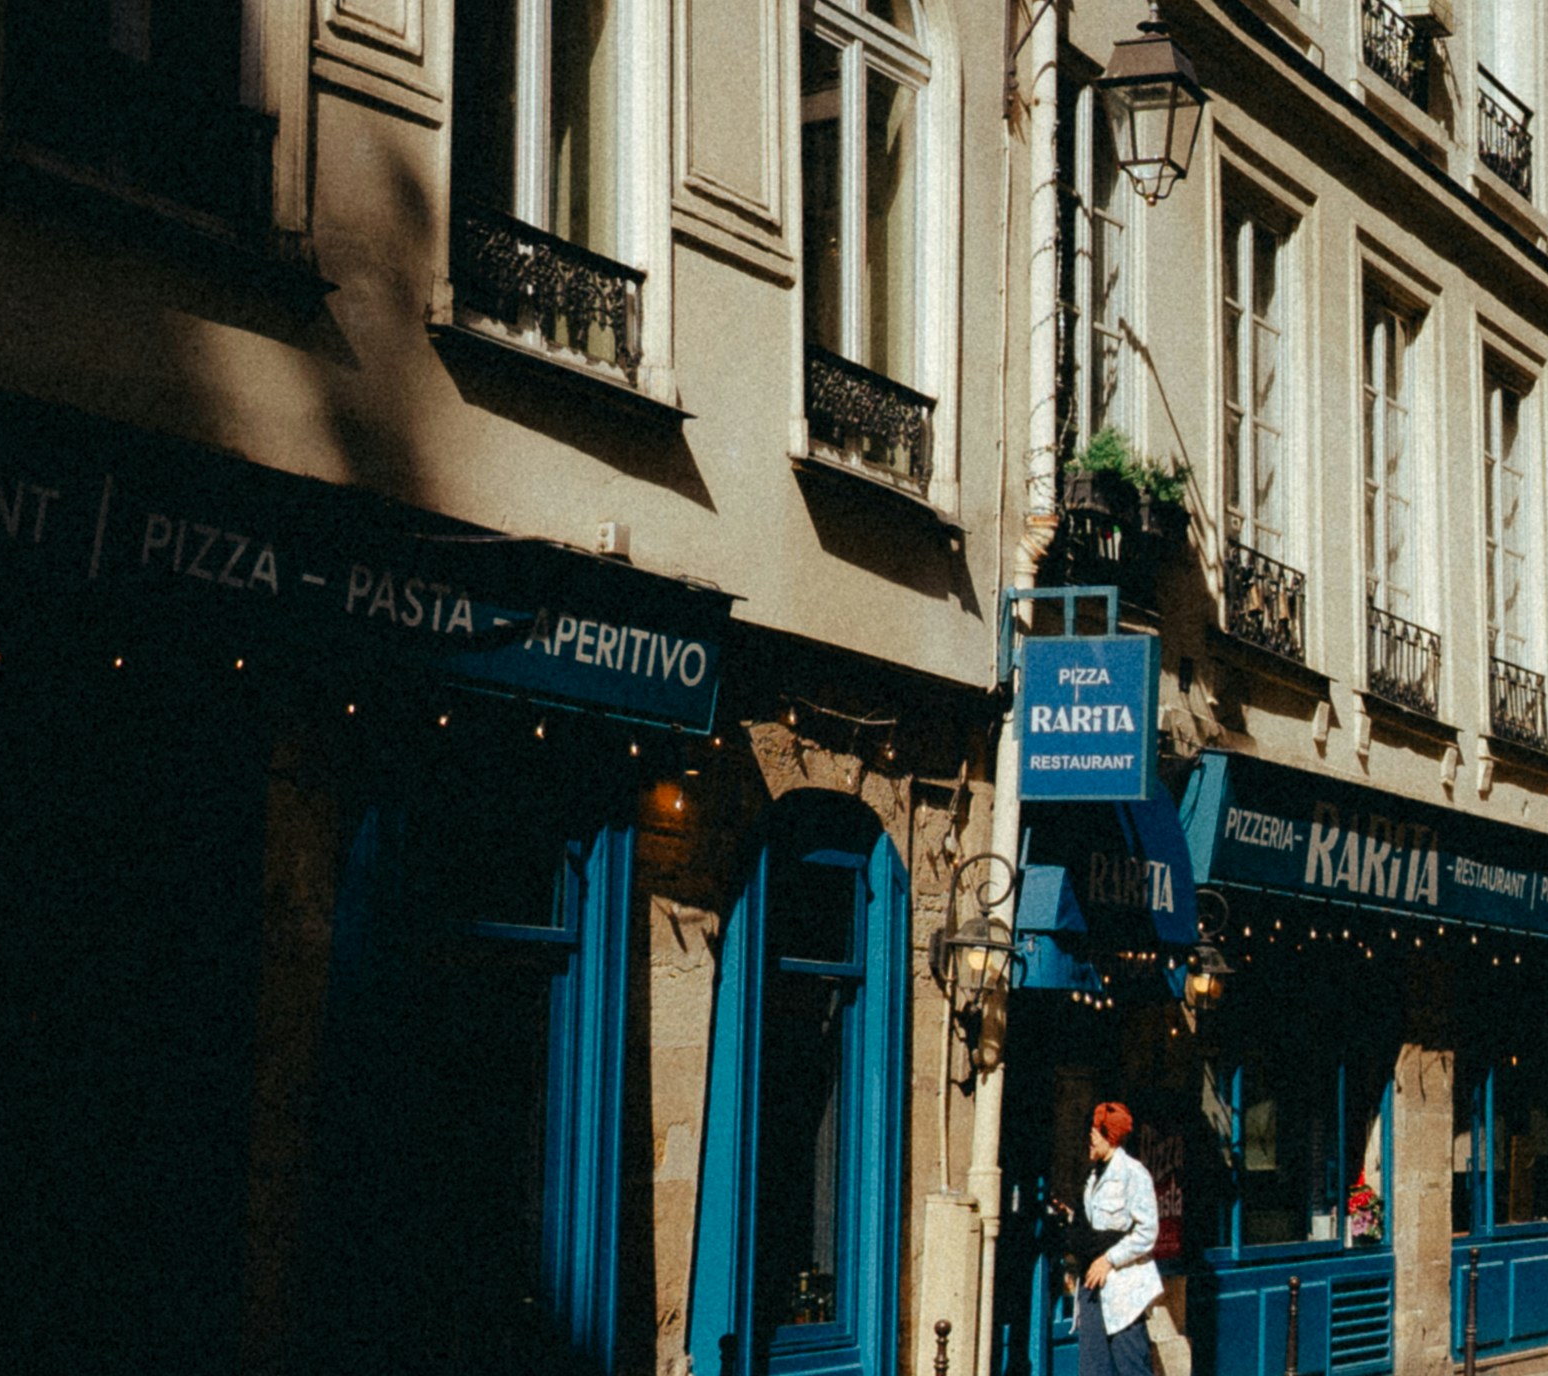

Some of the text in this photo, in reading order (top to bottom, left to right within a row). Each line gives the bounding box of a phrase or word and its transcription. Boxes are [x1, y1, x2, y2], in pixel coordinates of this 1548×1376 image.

[140, 513, 280, 596] PIZZA
[344, 563, 475, 638] PASTA
[524, 607, 708, 689] APERITIVO
[1058, 667, 1111, 685] PIZZA
[1030, 754, 1135, 770] RESTAURANT
